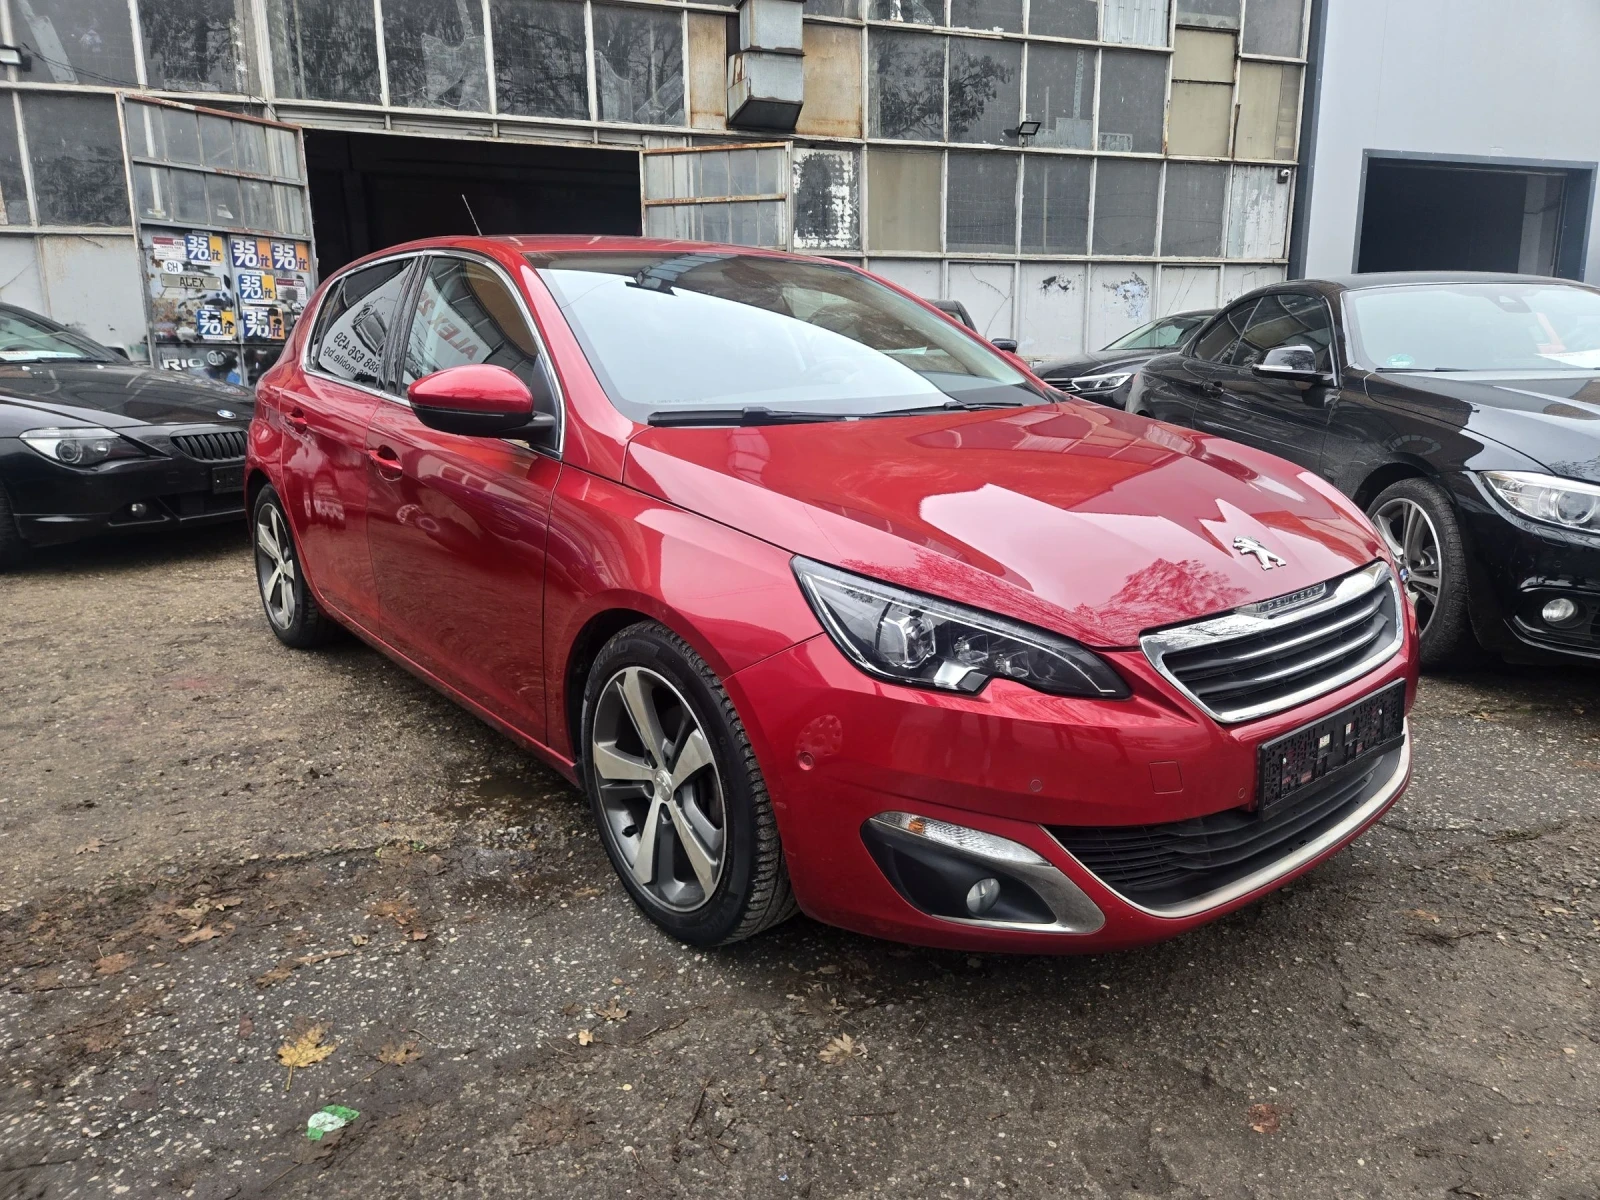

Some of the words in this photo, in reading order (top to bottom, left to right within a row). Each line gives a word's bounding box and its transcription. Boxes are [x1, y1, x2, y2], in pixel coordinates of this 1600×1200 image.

[187, 235, 208, 249] 35
[233, 240, 256, 254] 35
[273, 243, 294, 257] 35
[179, 277, 205, 288] ALEX
[240, 275, 260, 288] 35
[245, 311, 268, 324] 35
[162, 358, 205, 371] RIO
[1267, 587, 1320, 610] PEUGEOT
